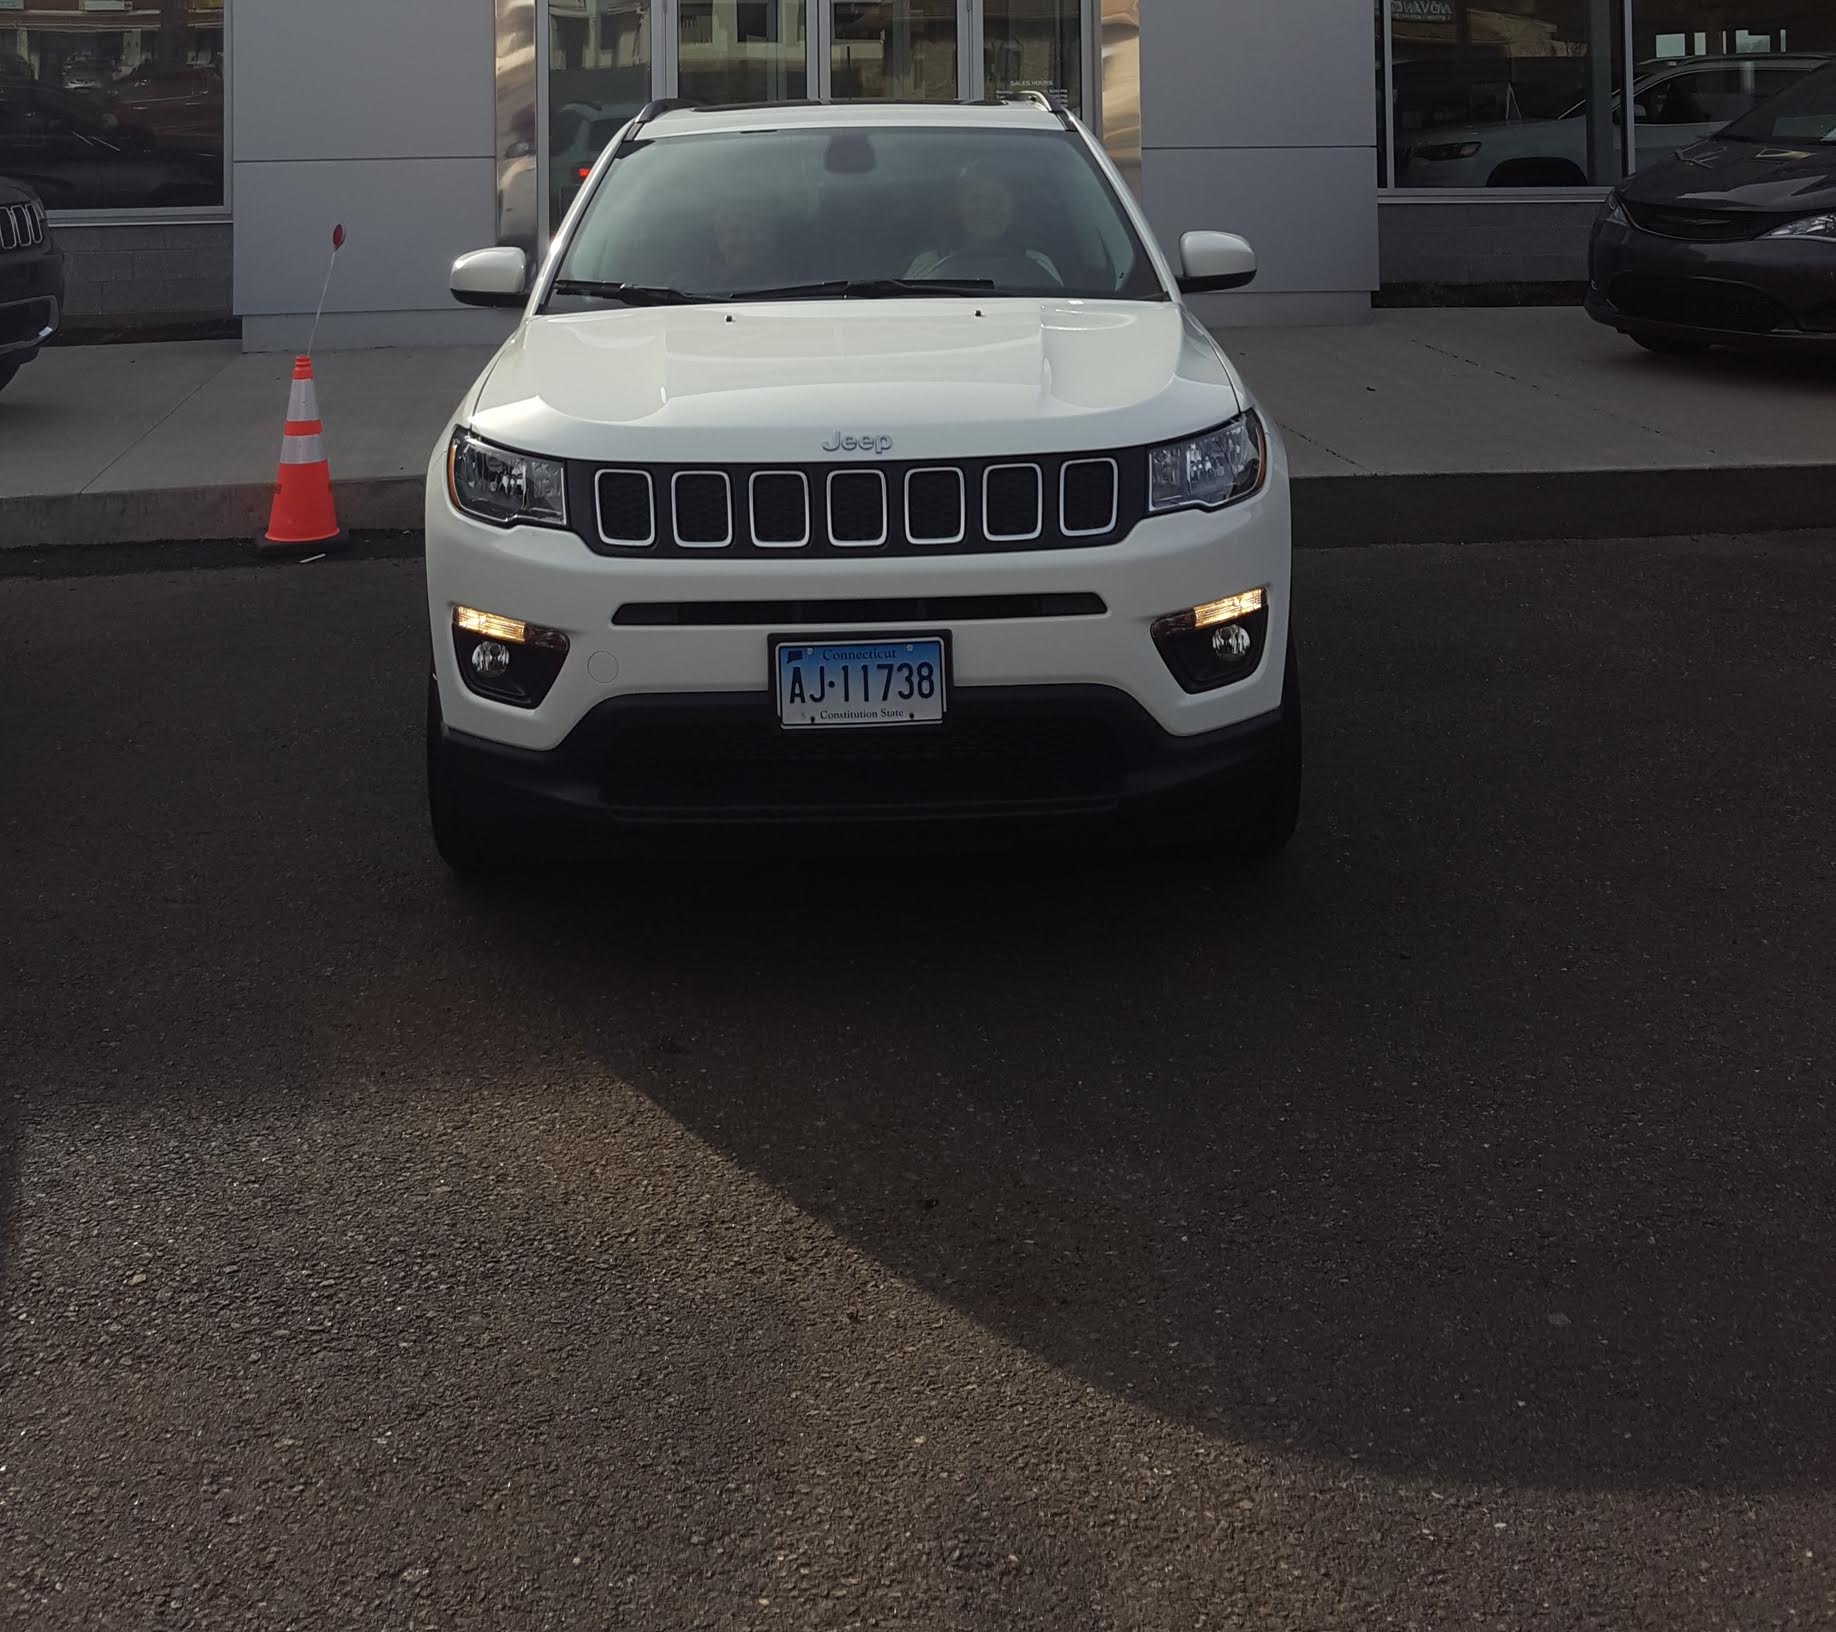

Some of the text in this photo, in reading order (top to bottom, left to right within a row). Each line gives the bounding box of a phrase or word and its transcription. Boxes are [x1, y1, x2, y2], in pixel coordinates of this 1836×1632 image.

[822, 429, 893, 454] Jeep
[822, 648, 897, 661] Connecticut
[820, 708, 904, 719] Constitution State
